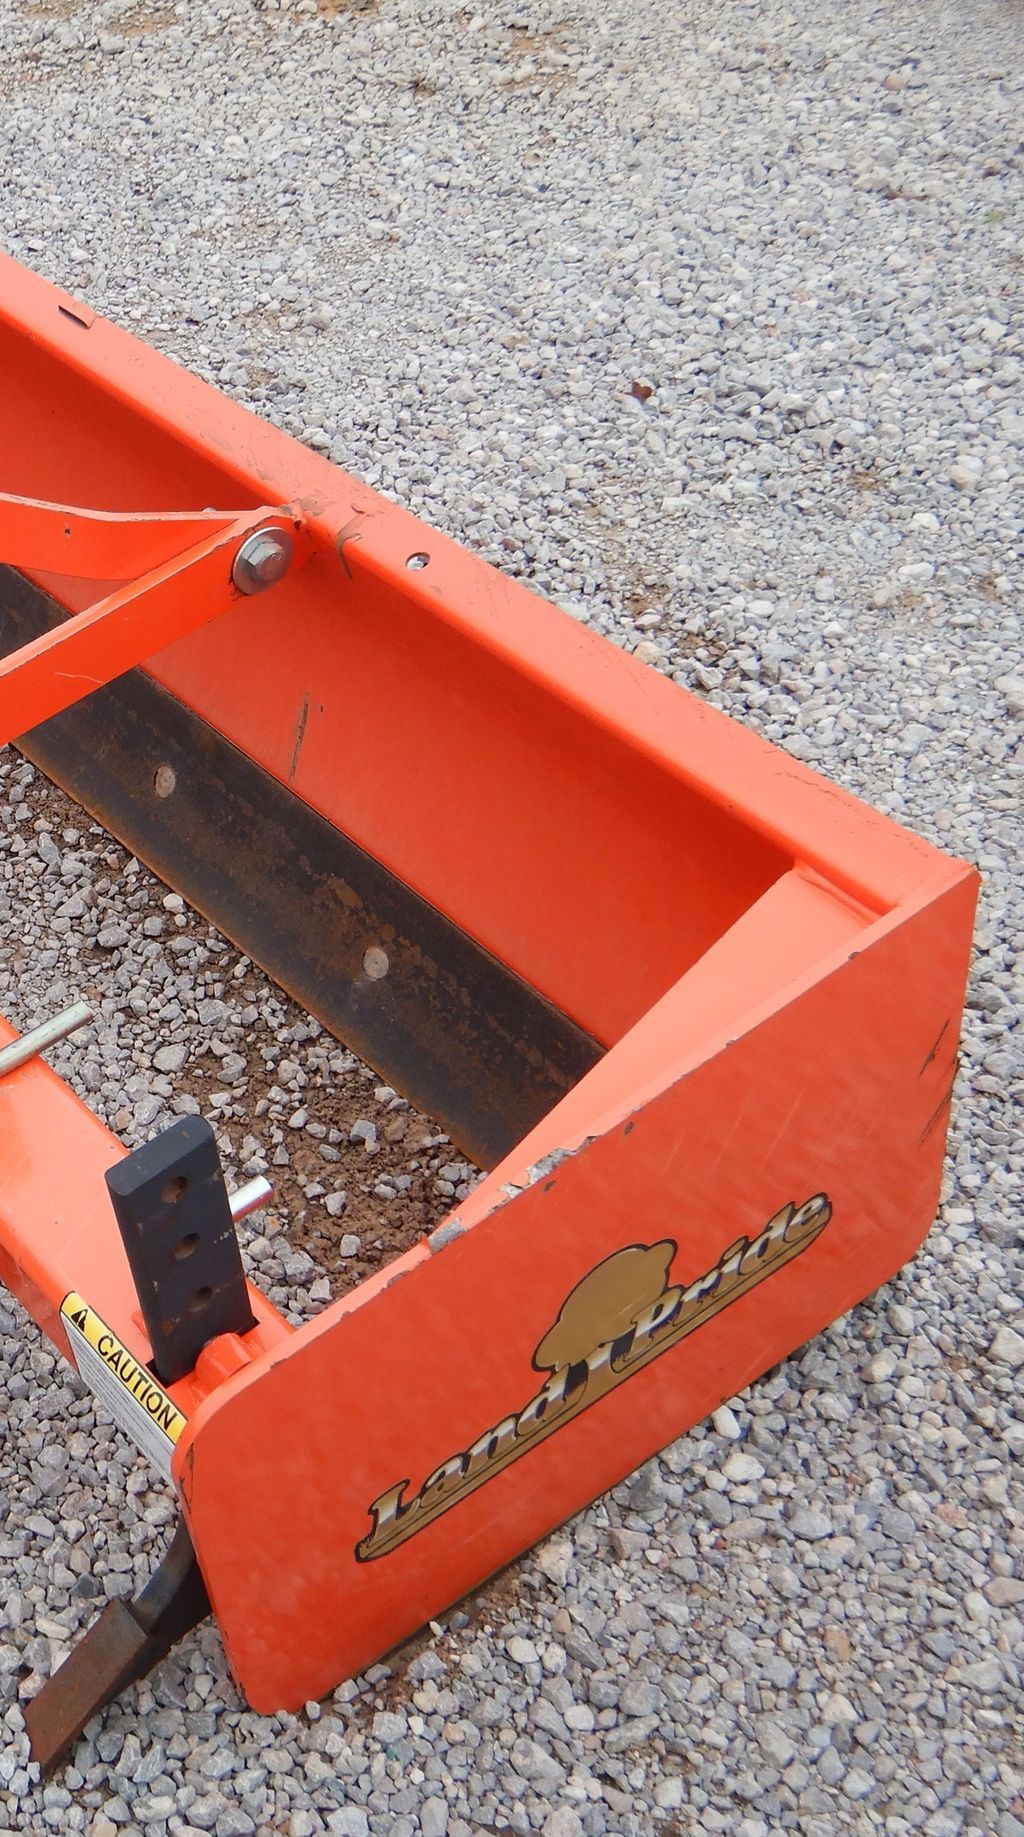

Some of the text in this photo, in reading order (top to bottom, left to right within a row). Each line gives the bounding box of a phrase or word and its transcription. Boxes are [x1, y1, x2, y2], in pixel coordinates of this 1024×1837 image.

[97, 1334, 178, 1432] CAUTION
[357, 1361, 590, 1551] Land
[612, 1192, 831, 1372] Pride
